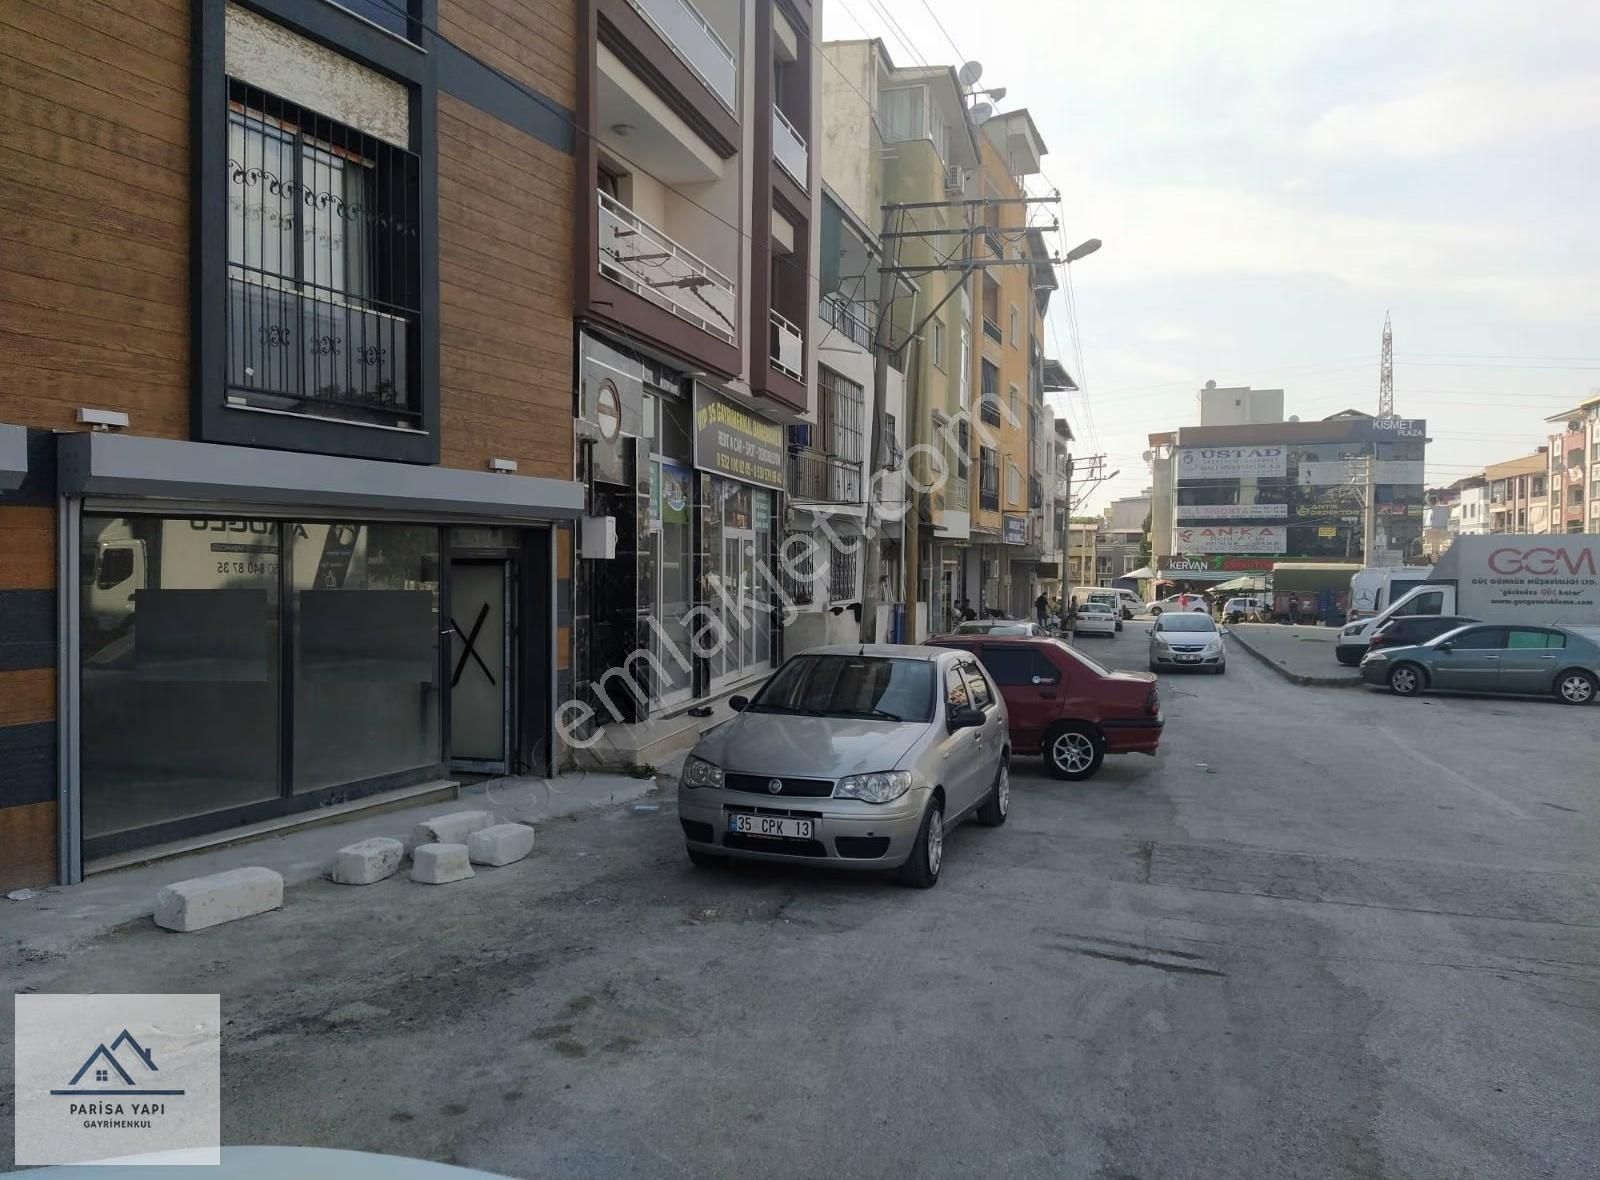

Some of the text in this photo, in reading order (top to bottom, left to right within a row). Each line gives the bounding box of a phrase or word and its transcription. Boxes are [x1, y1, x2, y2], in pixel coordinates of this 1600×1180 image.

[1372, 420, 1415, 430] KISMET
[1398, 429, 1423, 437] PLAZA
[1169, 559, 1208, 572] KERVAN
[1488, 547, 1597, 575] GGM
[738, 817, 809, 836] 35 CPK 13
